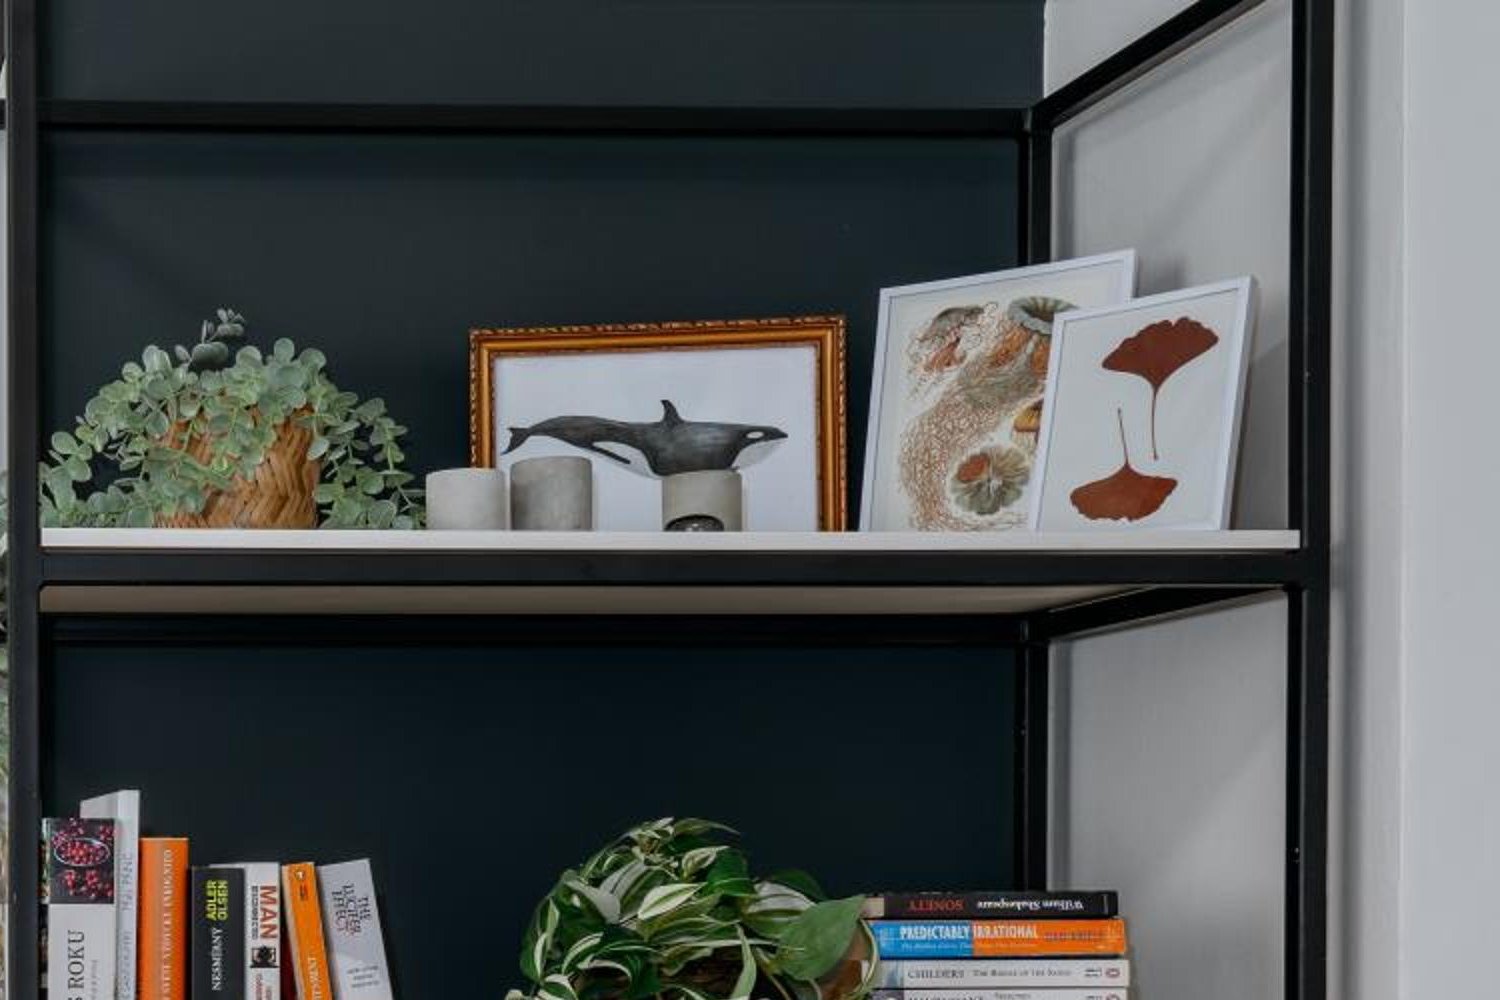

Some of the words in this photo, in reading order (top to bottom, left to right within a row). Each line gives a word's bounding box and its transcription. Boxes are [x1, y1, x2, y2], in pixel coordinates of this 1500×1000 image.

[205, 880, 217, 920] ADLER
[217, 880, 228, 920] OLSEN
[260, 885, 277, 938] MAN
[331, 890, 348, 934] EFFECT
[342, 883, 361, 935] LUCIFER
[357, 896, 371, 921] THE
[976, 898, 1040, 911] Shakespeare
[1041, 899, 1084, 910] William
[900, 925, 970, 939] PREDICTABLY
[973, 925, 1038, 939] IRRATIONAL
[67, 929, 85, 989] ROKU
[907, 969, 965, 979] CHILDERS
